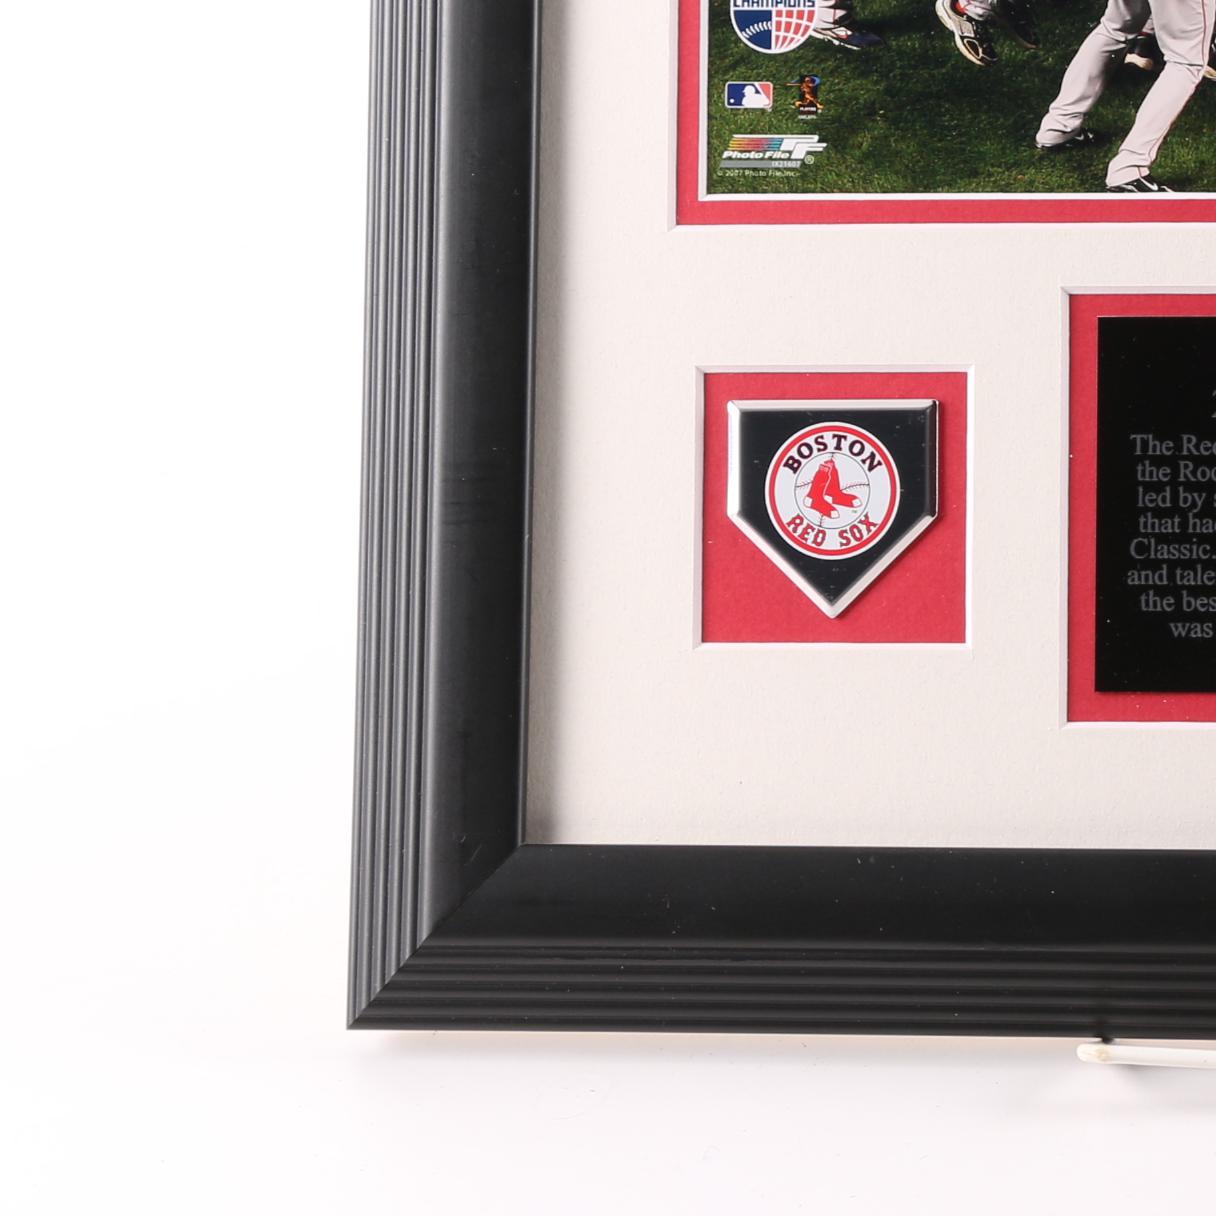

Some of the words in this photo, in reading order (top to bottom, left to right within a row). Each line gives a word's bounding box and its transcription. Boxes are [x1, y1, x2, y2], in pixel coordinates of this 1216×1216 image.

[721, 150, 764, 159] Photo
[764, 150, 790, 159] File
[782, 433, 884, 475] BOSTON
[1129, 432, 1175, 456] The
[1136, 458, 1172, 482] the
[1137, 484, 1172, 508] led
[1178, 485, 1207, 513] by
[785, 513, 828, 548] RED
[837, 512, 880, 548] SOX
[1138, 510, 1181, 534] that
[1129, 536, 1216, 561] Classic.
[1127, 563, 1169, 587] and
[1139, 589, 1175, 613] the
[1169, 622, 1214, 639] was
